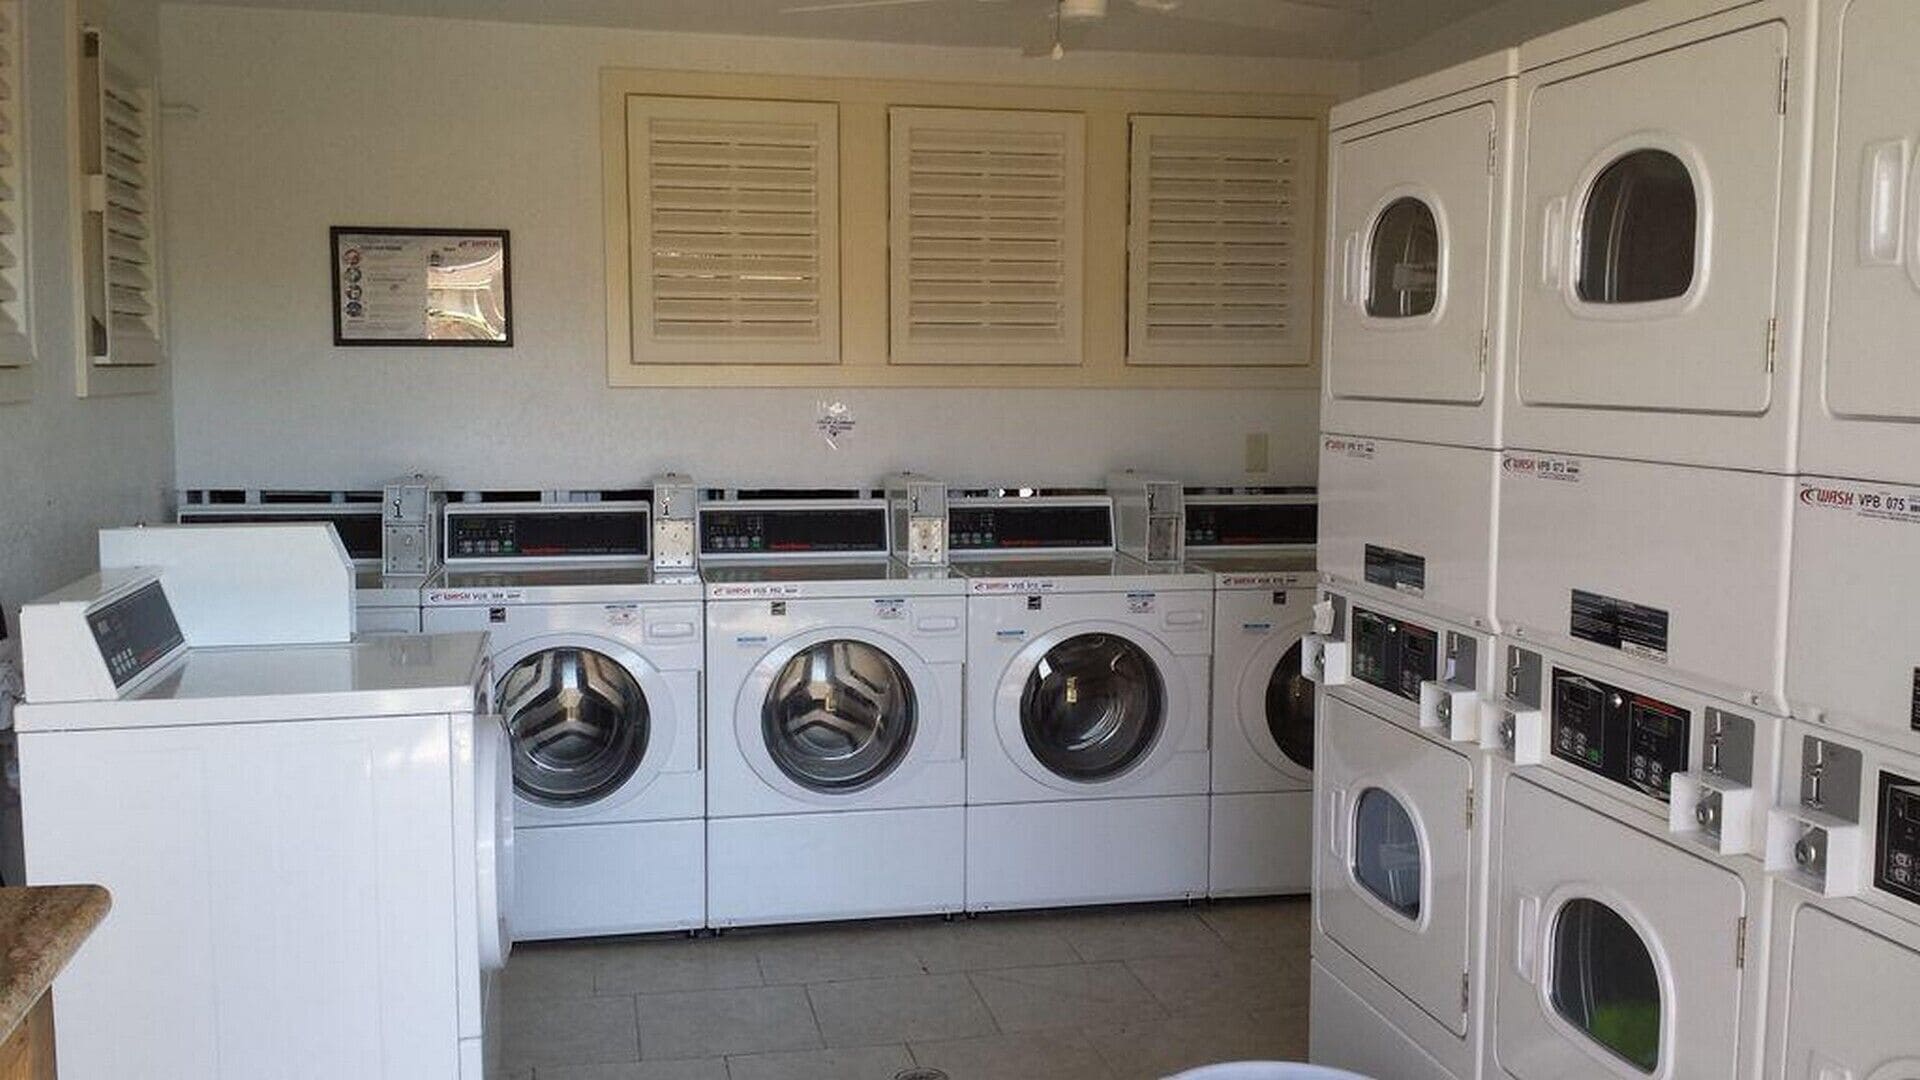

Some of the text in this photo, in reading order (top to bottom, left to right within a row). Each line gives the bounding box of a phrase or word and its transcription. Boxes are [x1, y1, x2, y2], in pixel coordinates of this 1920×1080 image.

[1817, 487, 1854, 506] WASH
[1859, 493, 1881, 509] VPB
[1886, 496, 1905, 511] 075
